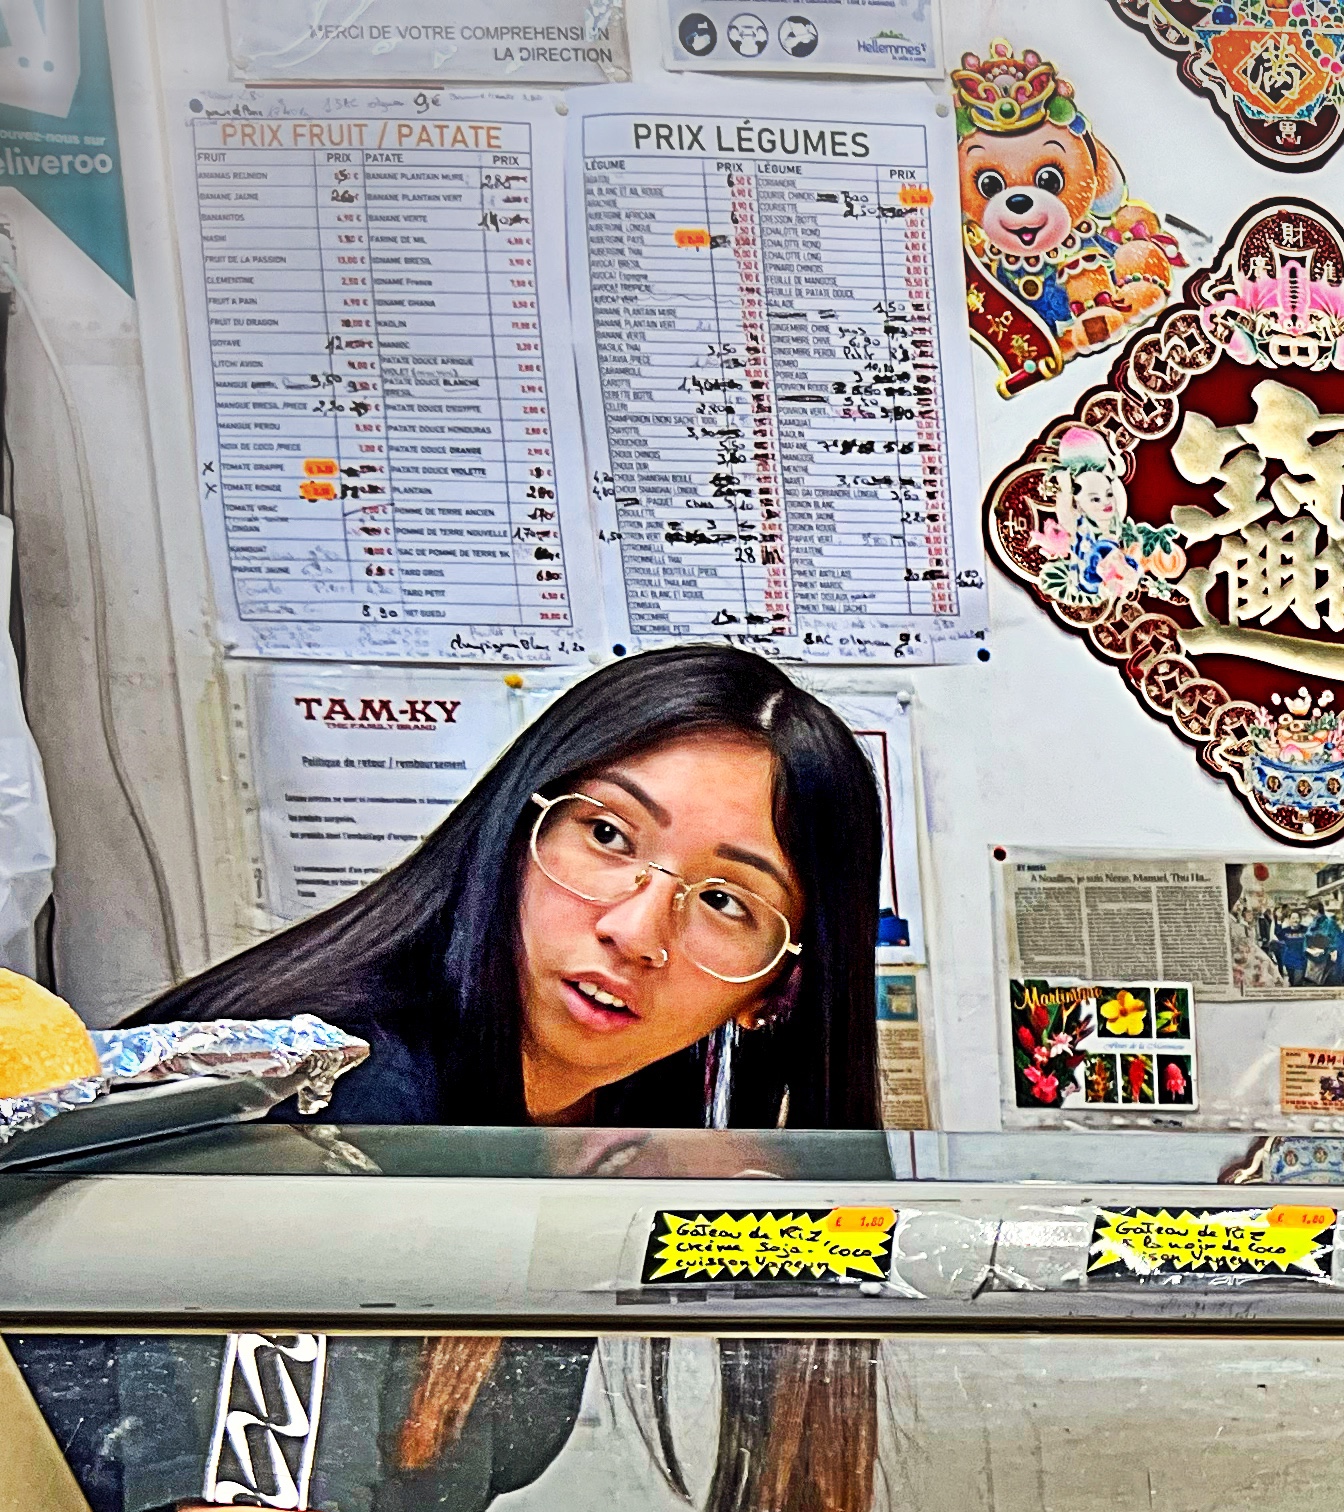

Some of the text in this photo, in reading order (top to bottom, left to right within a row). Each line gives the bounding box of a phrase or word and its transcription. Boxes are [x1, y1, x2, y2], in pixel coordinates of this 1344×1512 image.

[309, 23, 367, 40] MERCI
[370, 24, 393, 40] DE
[398, 25, 456, 41] VOTRE
[494, 47, 613, 63] LA DIRECTION
[221, 122, 502, 150] PRIX FRUIT PATATE
[633, 120, 871, 158] PRIX LÉGUMES
[197, 152, 352, 164] FRUIT PRIX
[365, 153, 519, 167] PATATE PRIX
[585, 158, 744, 173] LÉGUME PRIX
[757, 162, 916, 180] LÉGUME PRIX
[294, 697, 461, 723] TAM-KY
[861, 1216, 884, 1226] 1.80
[1302, 1212, 1325, 1223] 1.80
